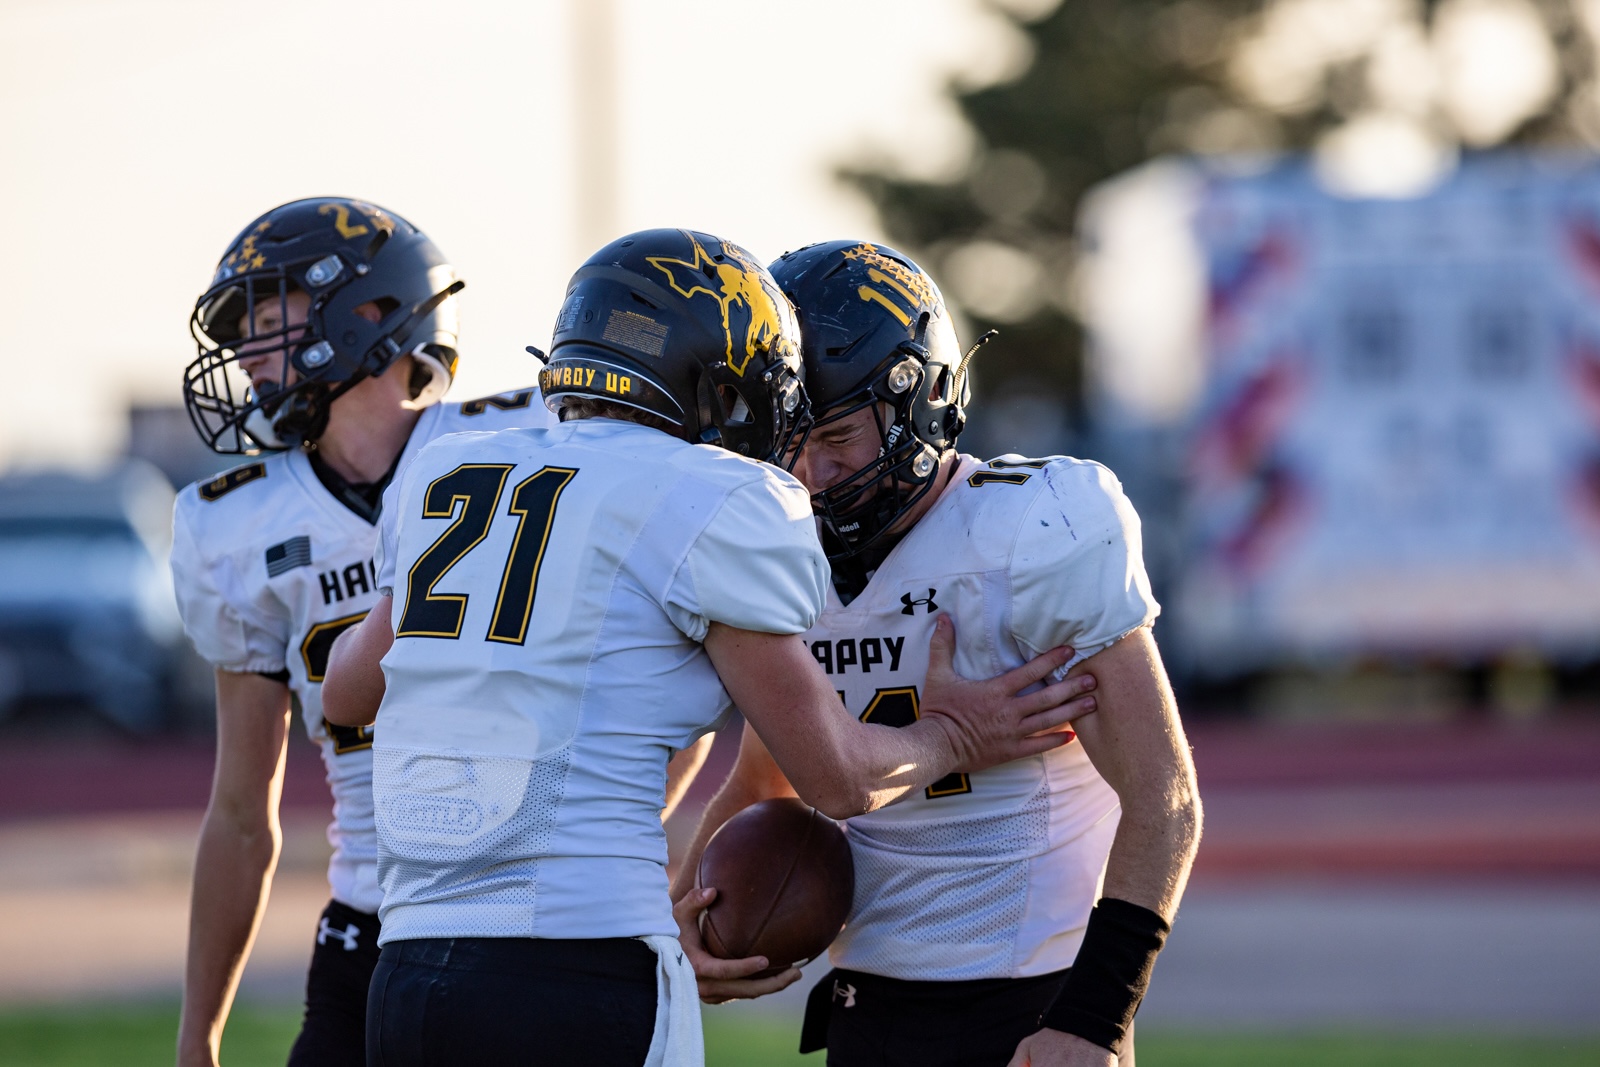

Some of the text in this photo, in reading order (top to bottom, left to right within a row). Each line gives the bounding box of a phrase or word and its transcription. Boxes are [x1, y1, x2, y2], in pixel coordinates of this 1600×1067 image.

[857, 266, 921, 327] 11
[606, 372, 631, 394] UP
[967, 459, 1051, 488] 11
[396, 463, 580, 646] 21
[319, 557, 377, 606] HA
[803, 636, 905, 674] APPY
